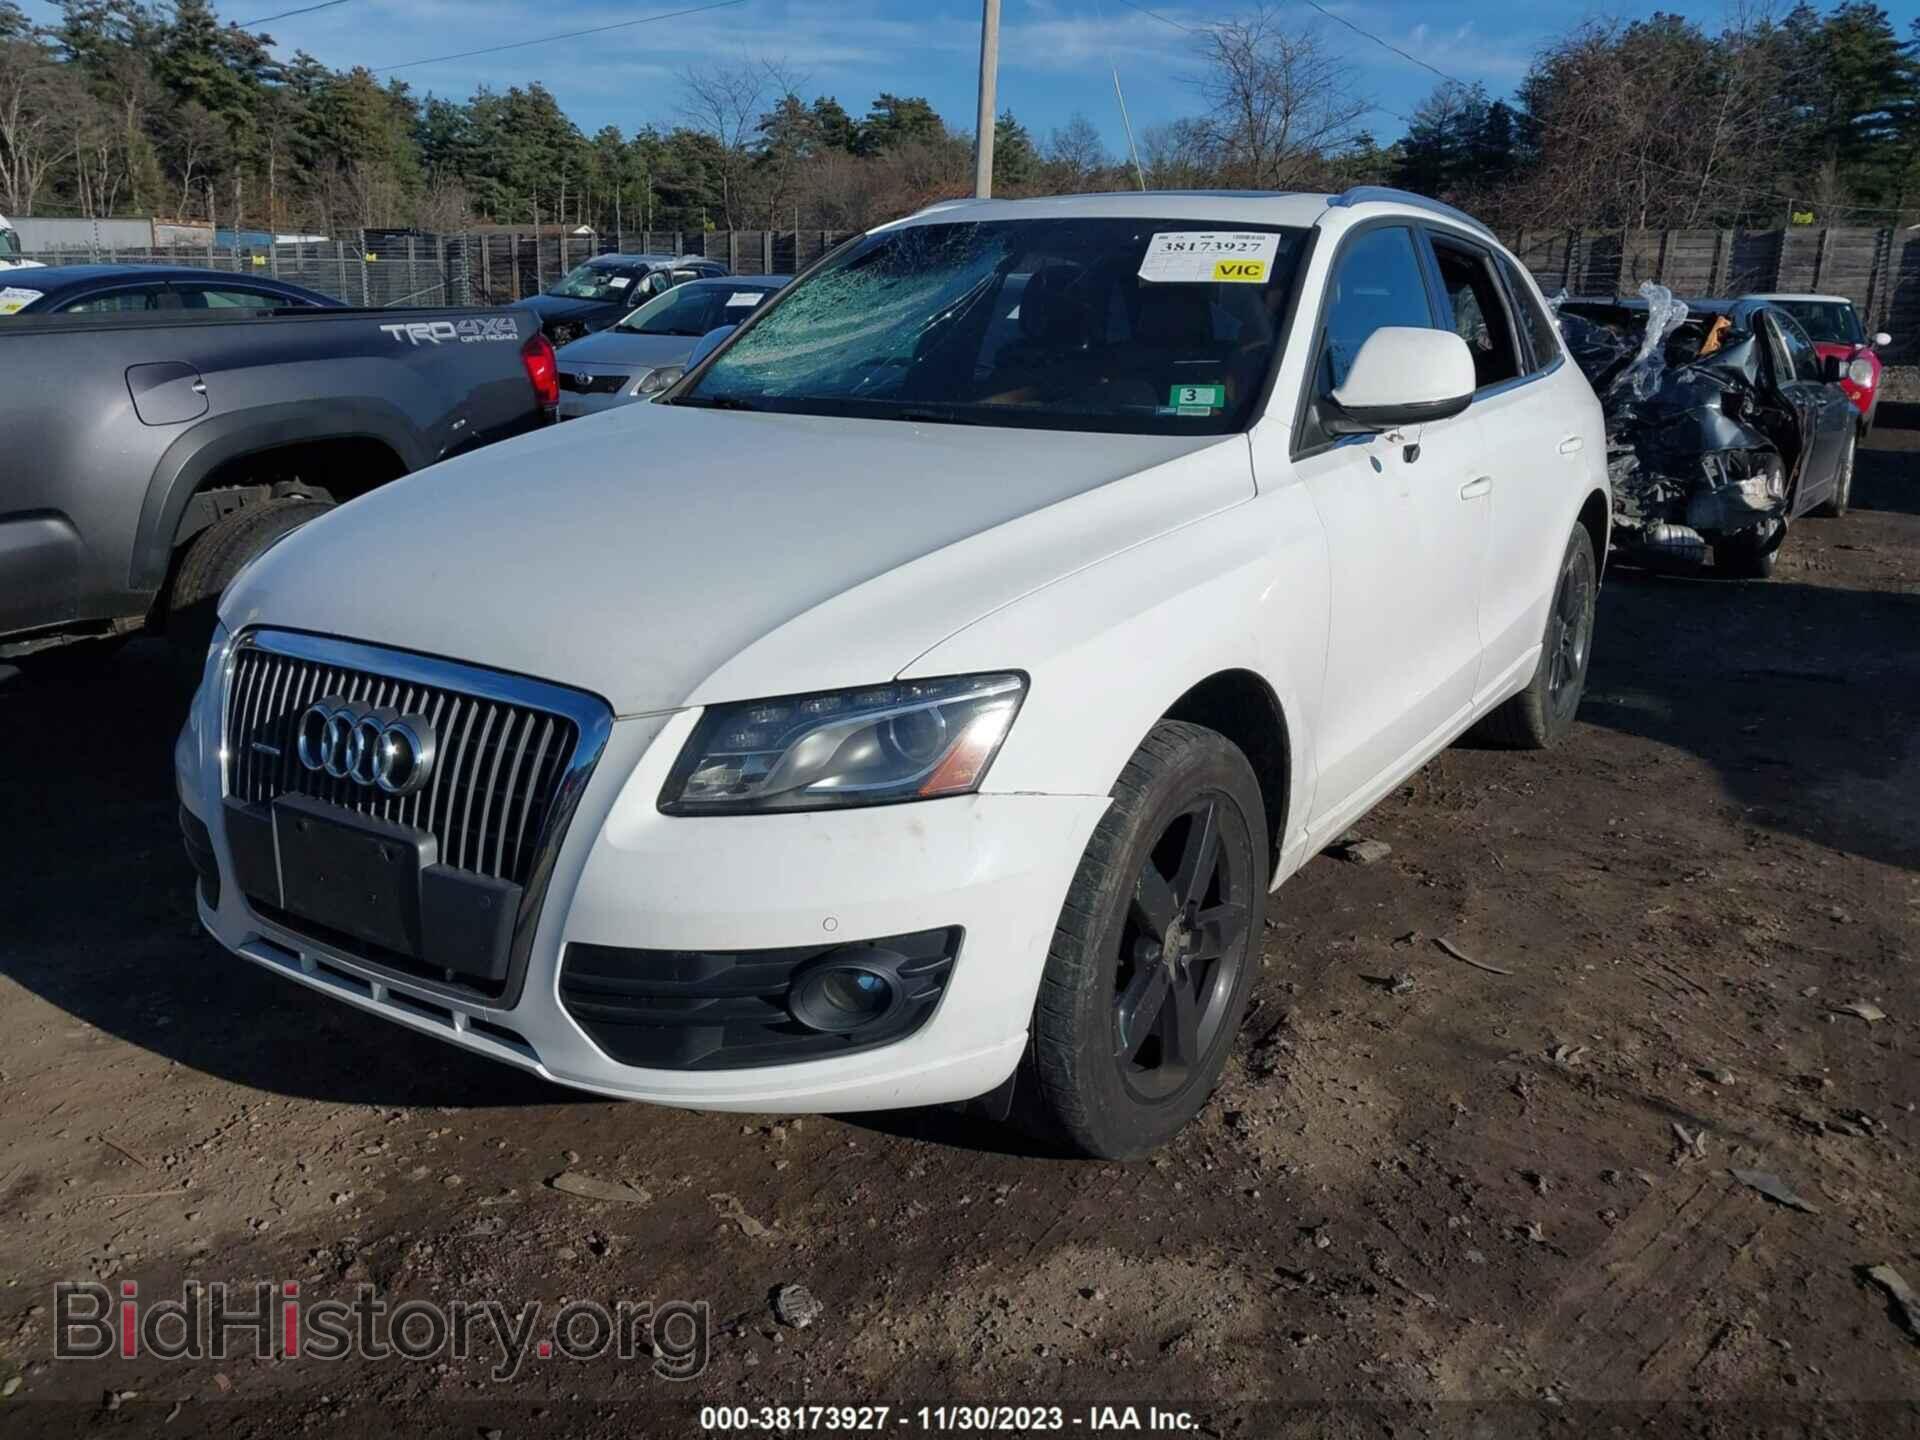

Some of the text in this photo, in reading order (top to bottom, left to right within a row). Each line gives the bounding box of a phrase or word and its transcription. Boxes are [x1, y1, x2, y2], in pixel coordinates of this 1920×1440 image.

[1160, 241, 1261, 252] 38173927
[1219, 264, 1260, 276] VIC
[460, 333, 518, 343] OFF ROAD
[1185, 388, 1197, 401] 3
